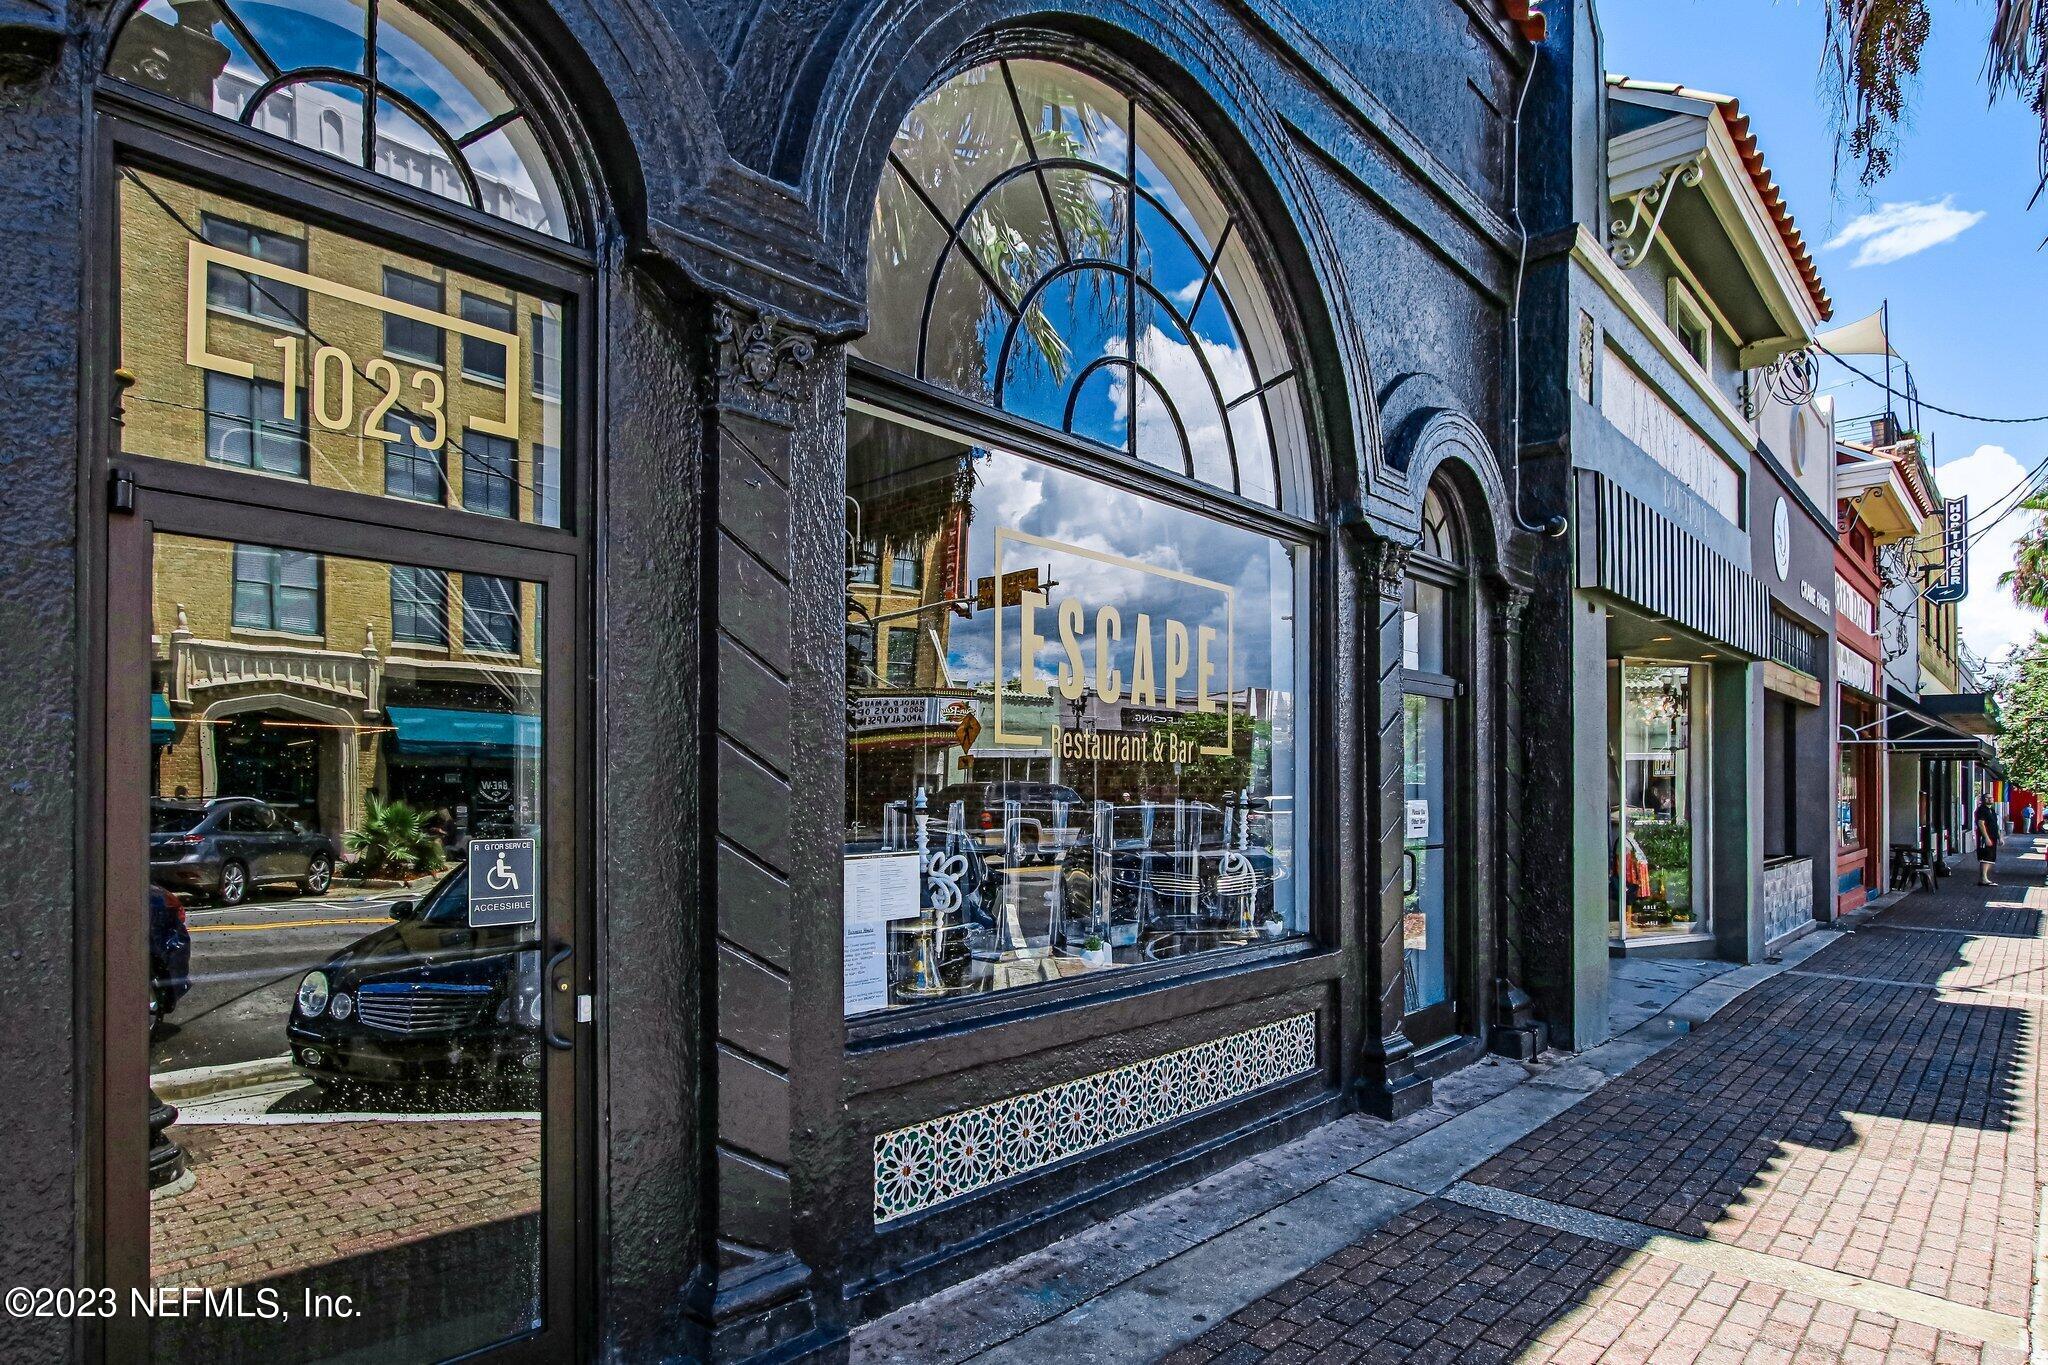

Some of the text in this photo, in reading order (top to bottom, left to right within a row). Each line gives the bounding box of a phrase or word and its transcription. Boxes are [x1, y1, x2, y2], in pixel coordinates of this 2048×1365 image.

[273, 336, 446, 450] 1023
[1949, 503, 1961, 585] HOPTINGER
[1853, 593, 1869, 634] DAY
[1021, 589, 1216, 713] ESCAPE
[1052, 724, 1194, 764] Restaurant & Bar
[504, 841, 531, 850] SERVCE
[474, 901, 531, 912] ACCESSIBLE
